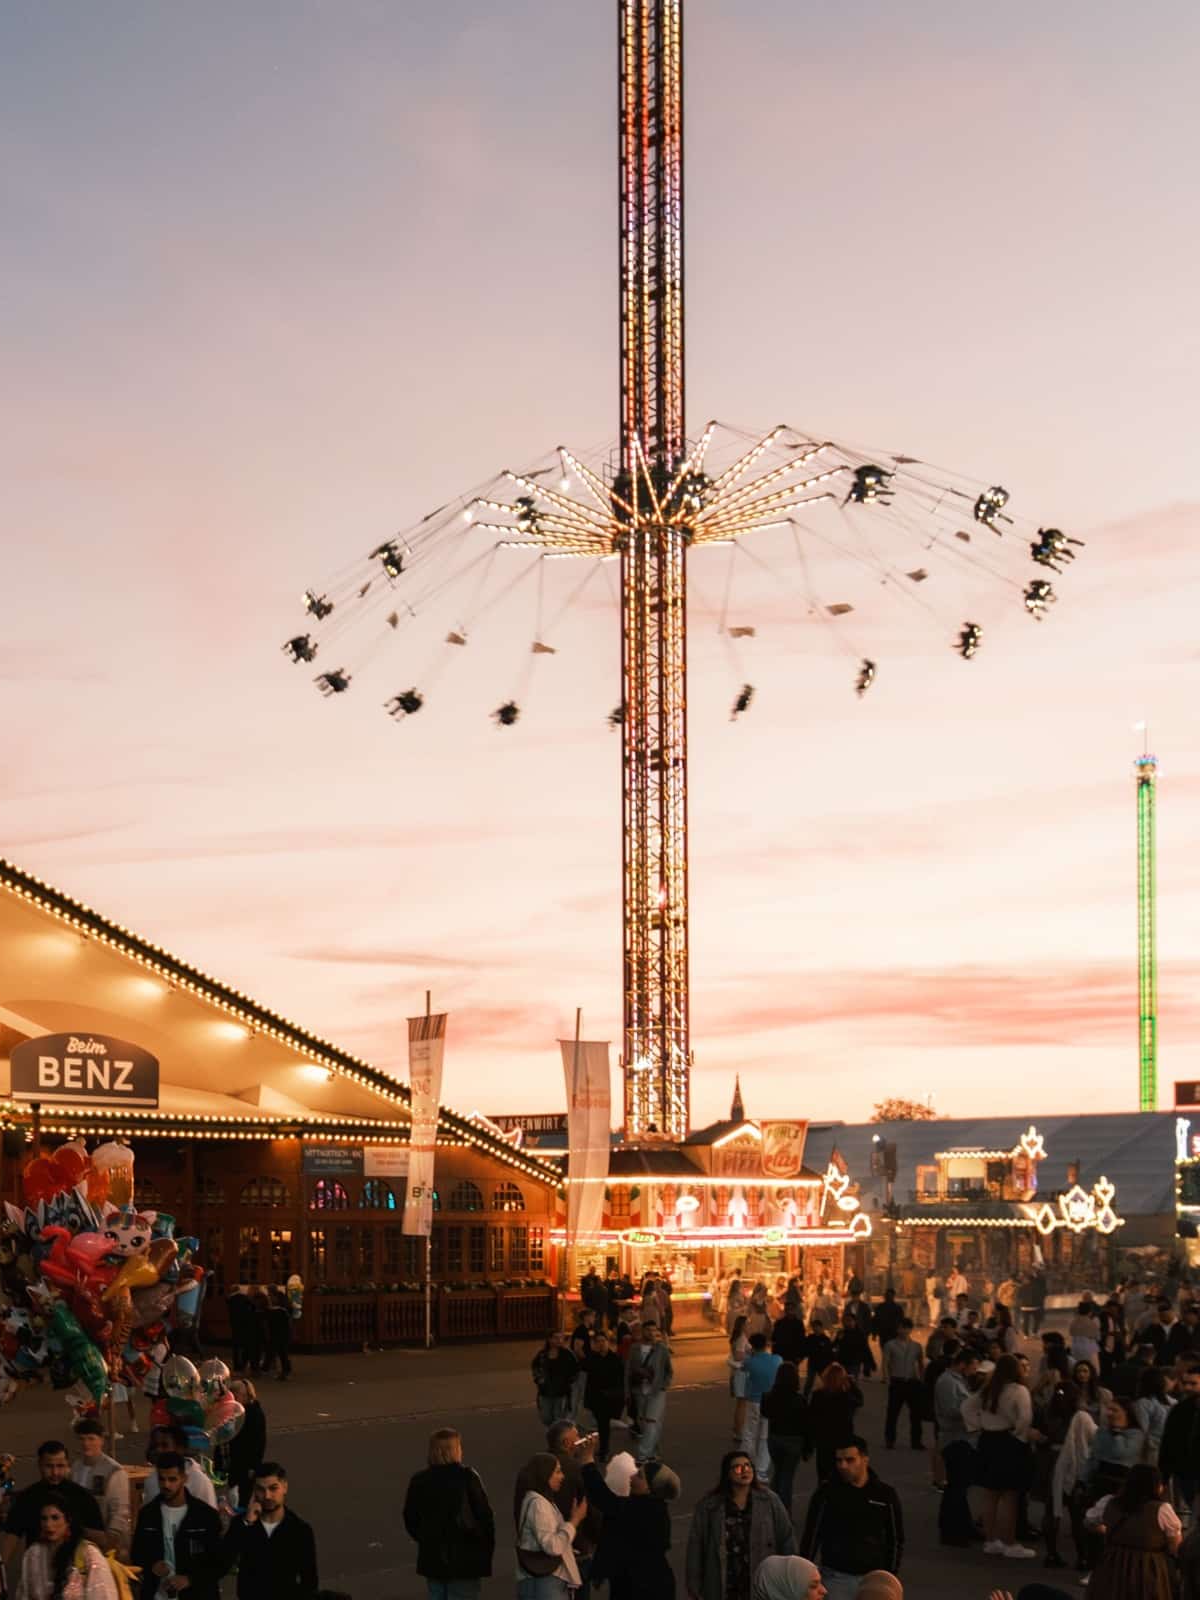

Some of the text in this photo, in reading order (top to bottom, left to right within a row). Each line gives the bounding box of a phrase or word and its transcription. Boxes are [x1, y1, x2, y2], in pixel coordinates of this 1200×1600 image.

[66, 1036, 107, 1055] Beim
[38, 1056, 134, 1091] BENZ
[500, 1116, 559, 1133] WASENWIRT
